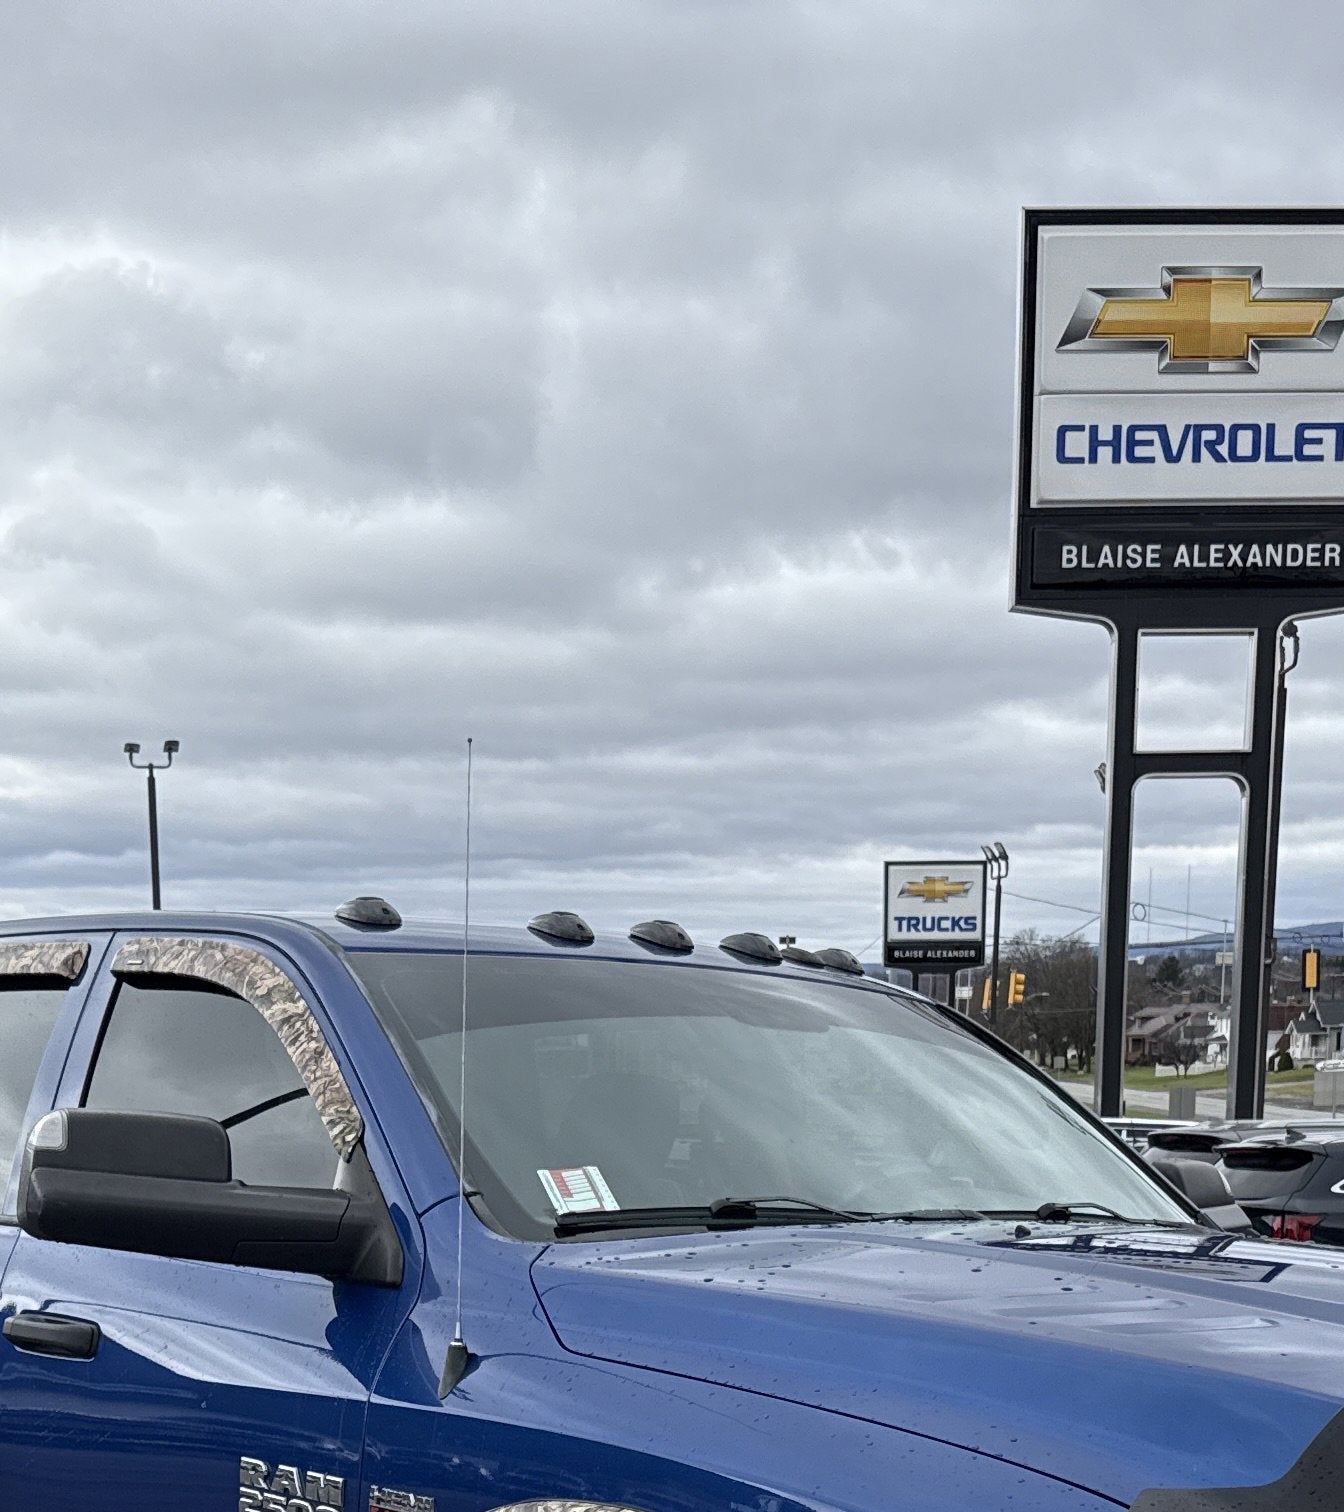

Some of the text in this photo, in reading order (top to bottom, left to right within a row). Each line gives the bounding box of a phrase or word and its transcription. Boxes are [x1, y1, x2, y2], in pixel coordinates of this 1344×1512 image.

[1061, 543, 1342, 569] BLAISE ALEXANDER
[894, 916, 977, 932] TRUCKS
[894, 950, 975, 958] BLAISE ALEXANDER
[240, 1456, 345, 1507] RAM
